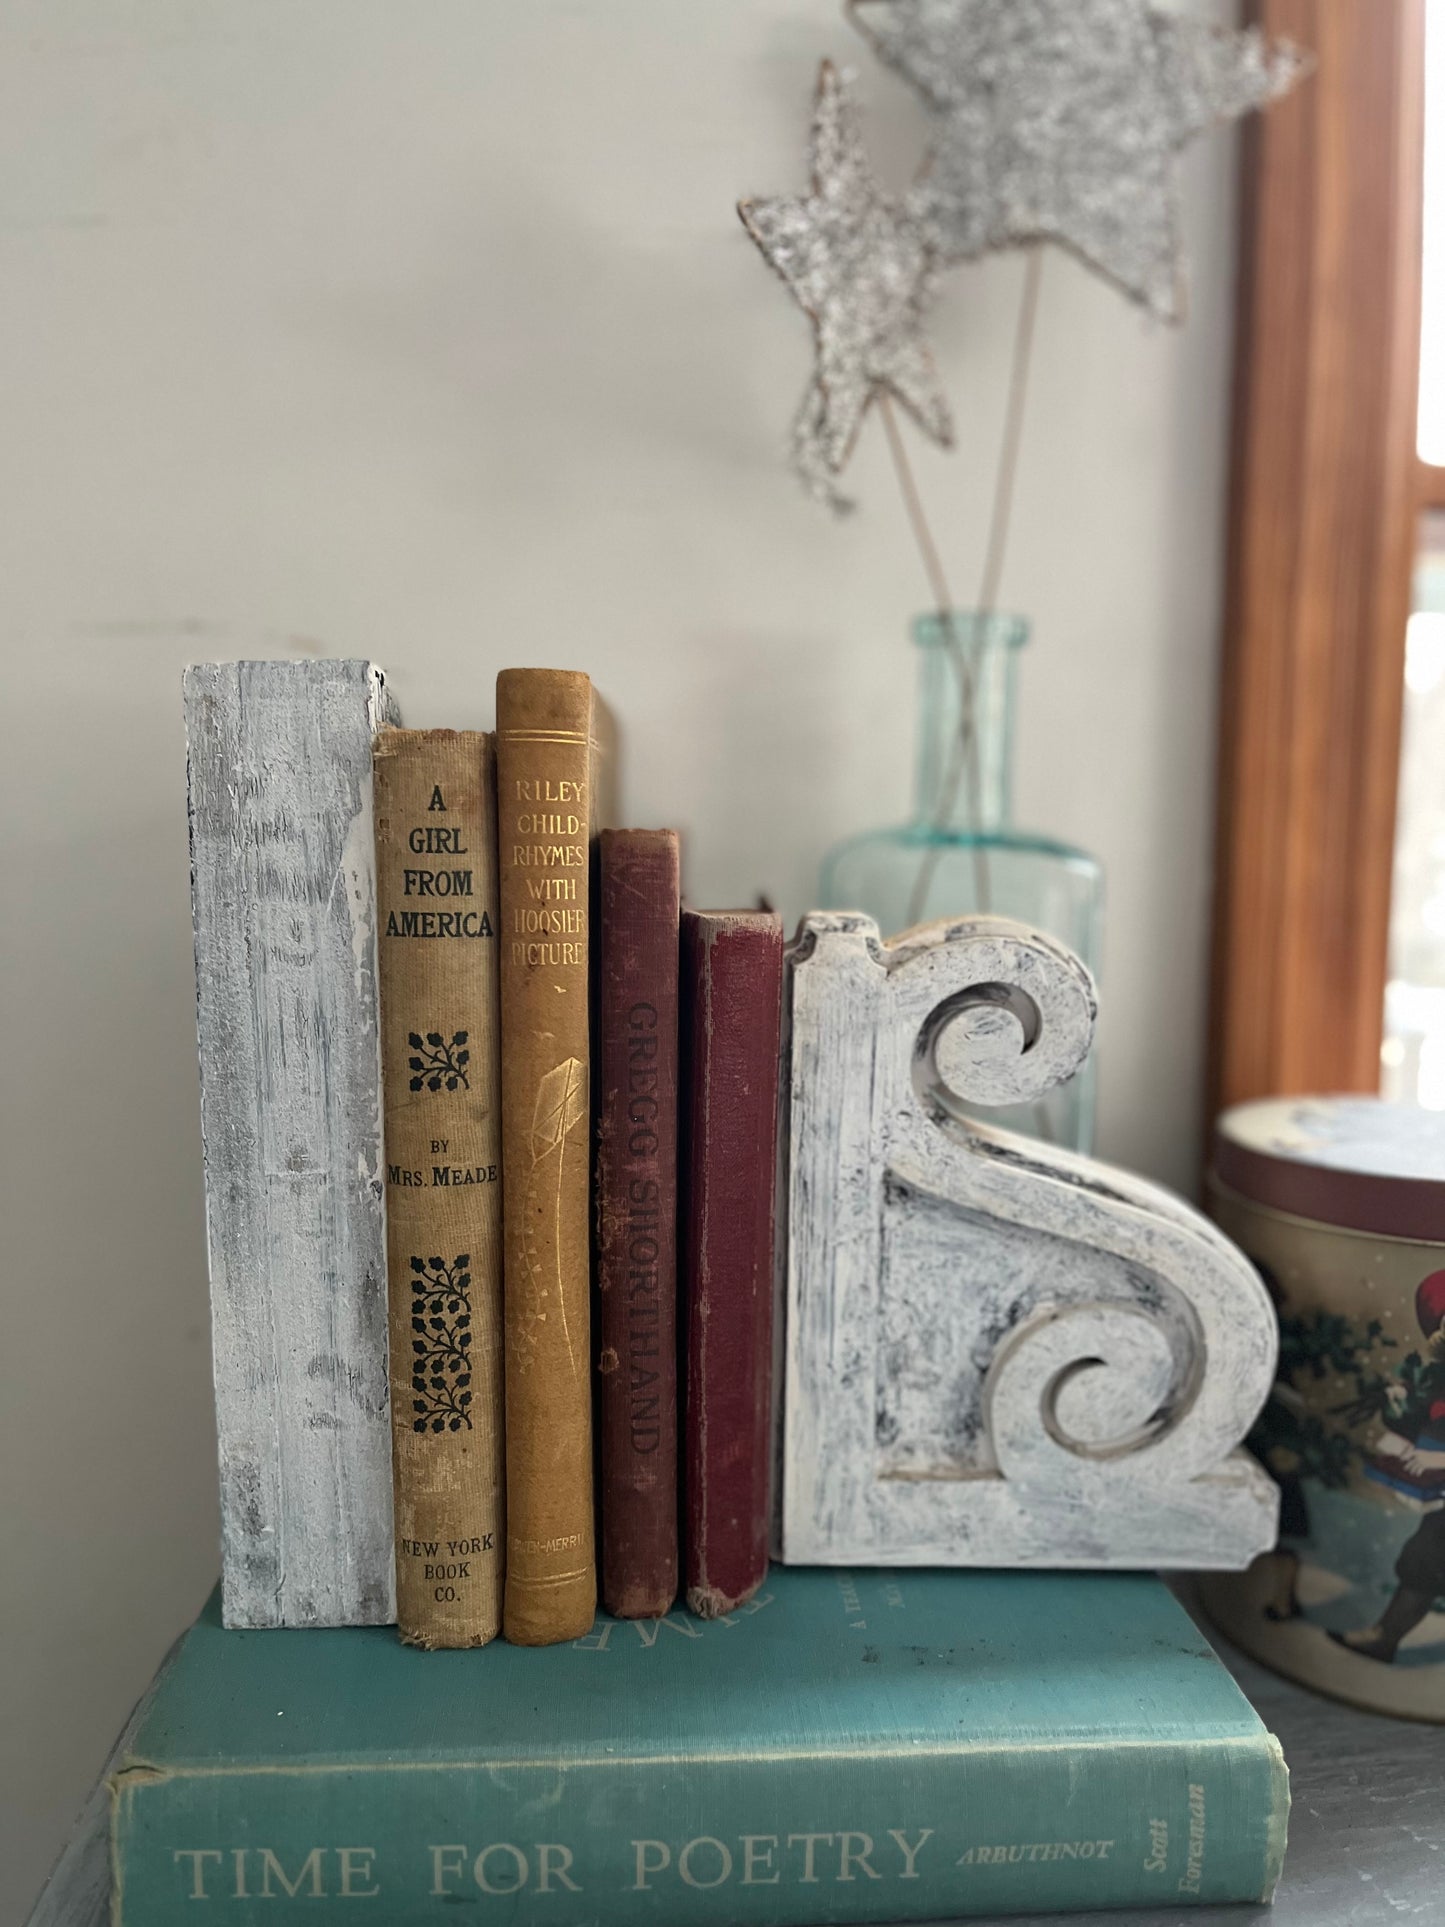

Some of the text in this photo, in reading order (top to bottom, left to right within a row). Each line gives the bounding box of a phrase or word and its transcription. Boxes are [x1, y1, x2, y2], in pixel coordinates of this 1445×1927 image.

[428, 785, 447, 811] A
[516, 780, 586, 803] RILEY
[518, 814, 587, 835] CHILD-
[408, 828, 468, 854] GIRL
[513, 846, 584, 866] RHYMES
[403, 870, 473, 896] FROM
[526, 879, 576, 900] WITH
[386, 911, 494, 938] AMERICA
[514, 909, 584, 933] HOOSIER
[628, 1002, 659, 1157] GREGG
[430, 1140, 449, 1154] BY
[628, 1179, 660, 1455] SHORTHAND
[402, 1532, 495, 1557] NEW YORK
[424, 1562, 471, 1580] BOOK
[434, 1586, 461, 1603] CO.
[1144, 1818, 1168, 1873] Scott
[1178, 1784, 1205, 1894] Foresman
[173, 1829, 1117, 1900] TIME FOR POETRY ARBUTHNOT
